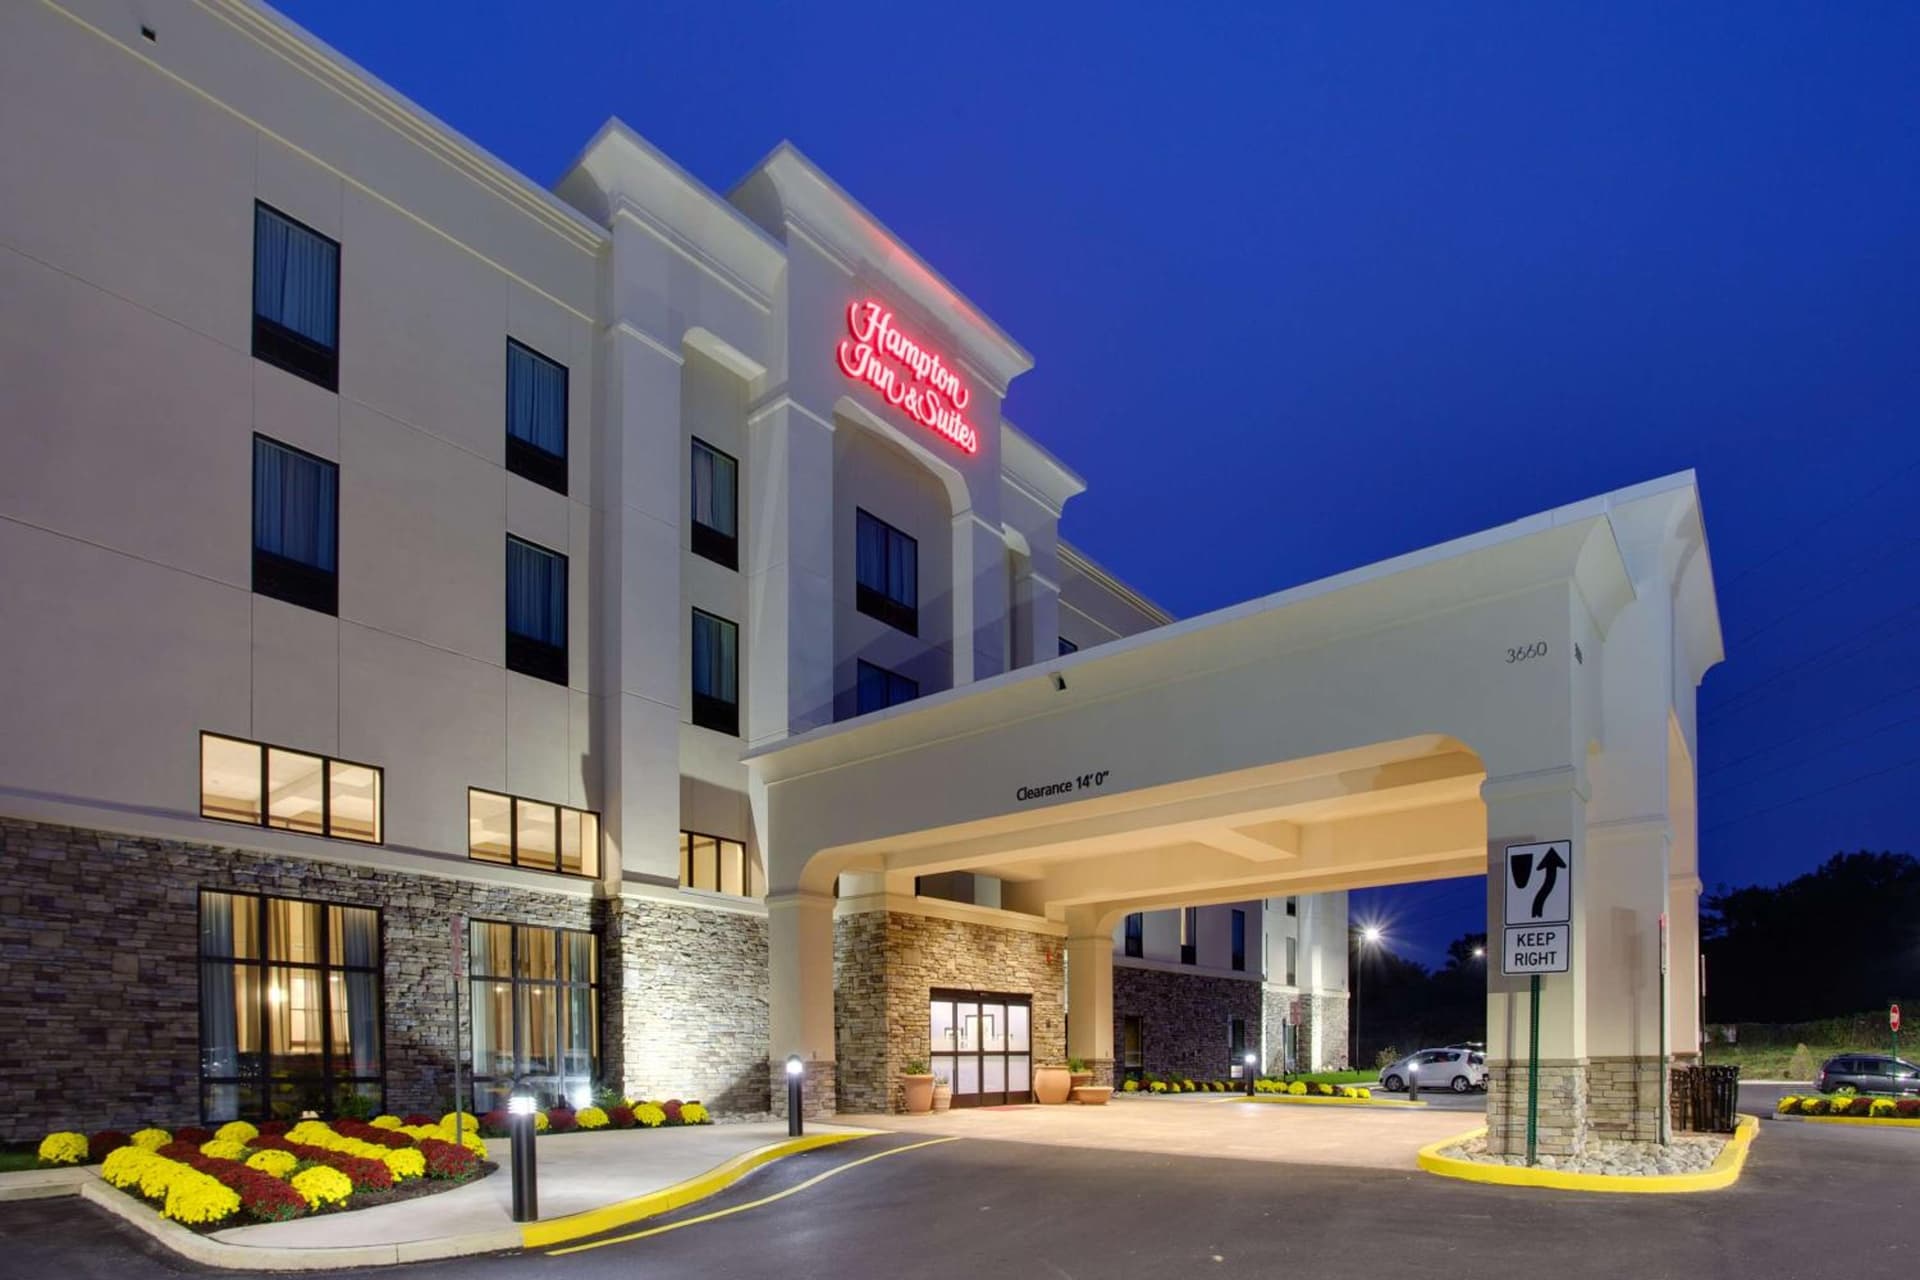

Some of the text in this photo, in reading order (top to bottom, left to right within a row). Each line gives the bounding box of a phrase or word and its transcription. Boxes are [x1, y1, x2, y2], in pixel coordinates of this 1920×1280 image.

[849, 301, 969, 409] Hampton
[838, 340, 977, 453] Inn & Suites
[1505, 641, 1548, 664] 3660
[1016, 781, 1073, 801] Clearance
[1516, 932, 1556, 947] KEEP
[1514, 951, 1557, 966] RIGHT
